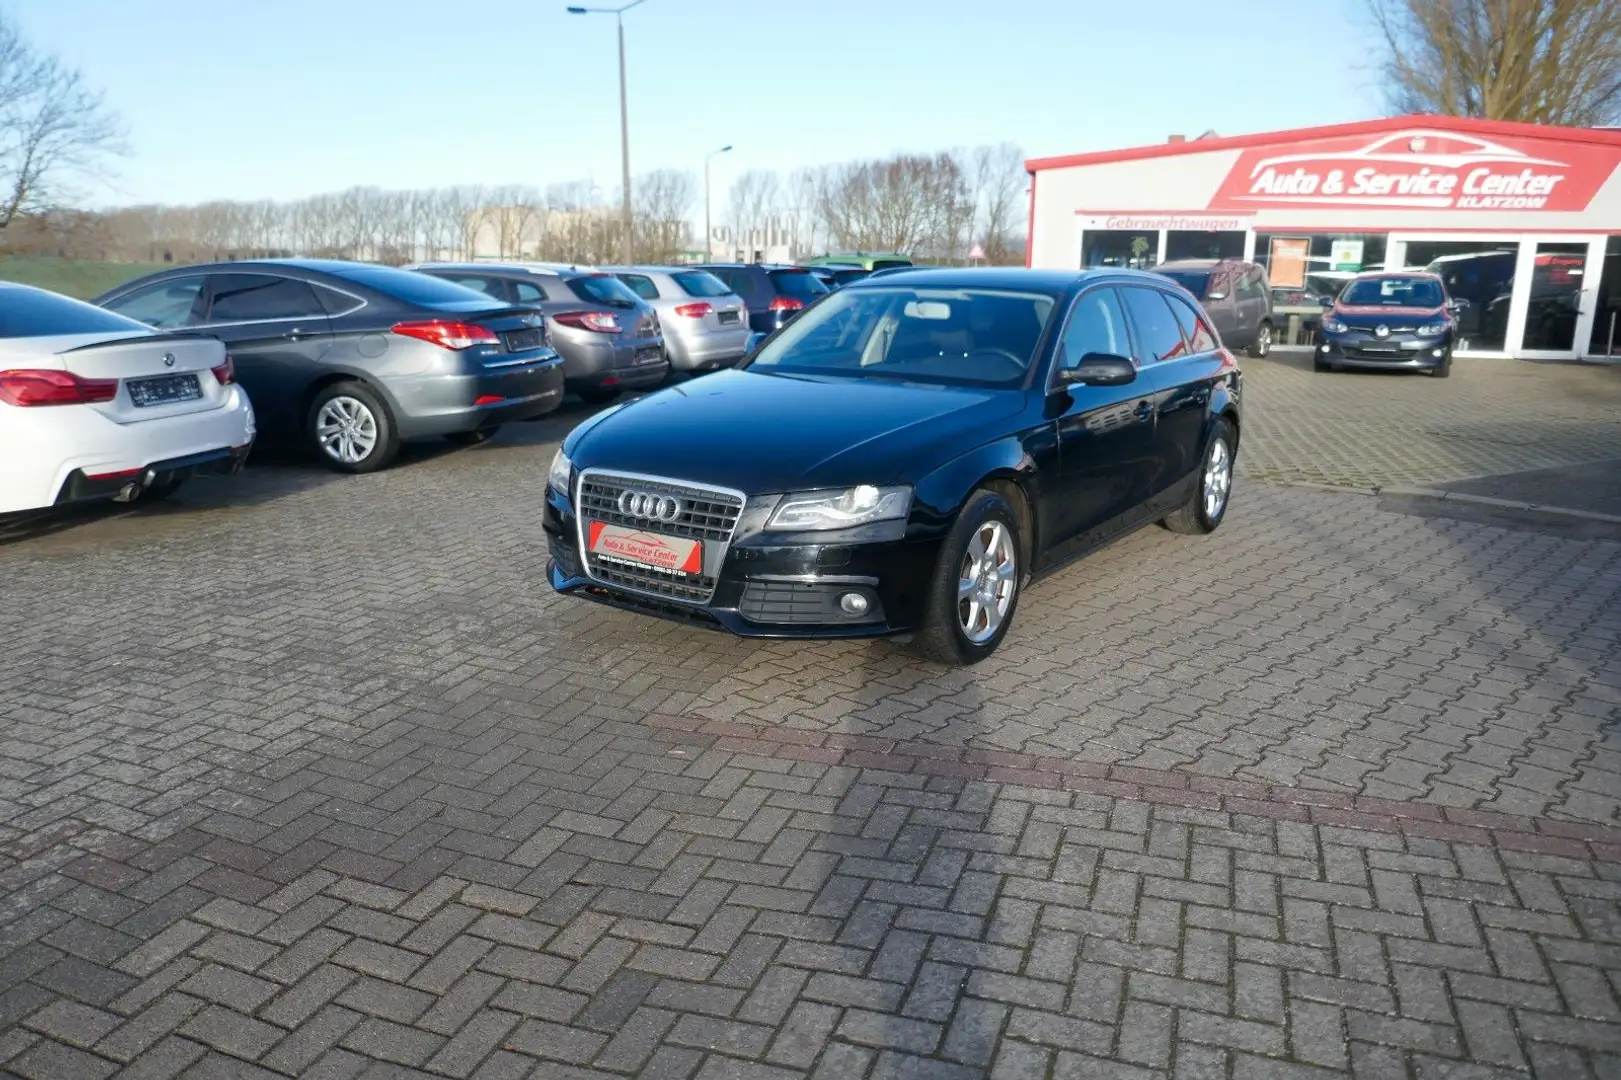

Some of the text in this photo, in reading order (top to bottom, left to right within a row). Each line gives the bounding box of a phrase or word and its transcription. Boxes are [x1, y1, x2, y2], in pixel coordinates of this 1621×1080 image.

[1250, 167, 1565, 195] Auto & Service Center
[1456, 195, 1548, 209] KLATZOW
[1105, 215, 1239, 232] Gebrauchtwagen
[603, 538, 678, 561] Auto & Service Center
